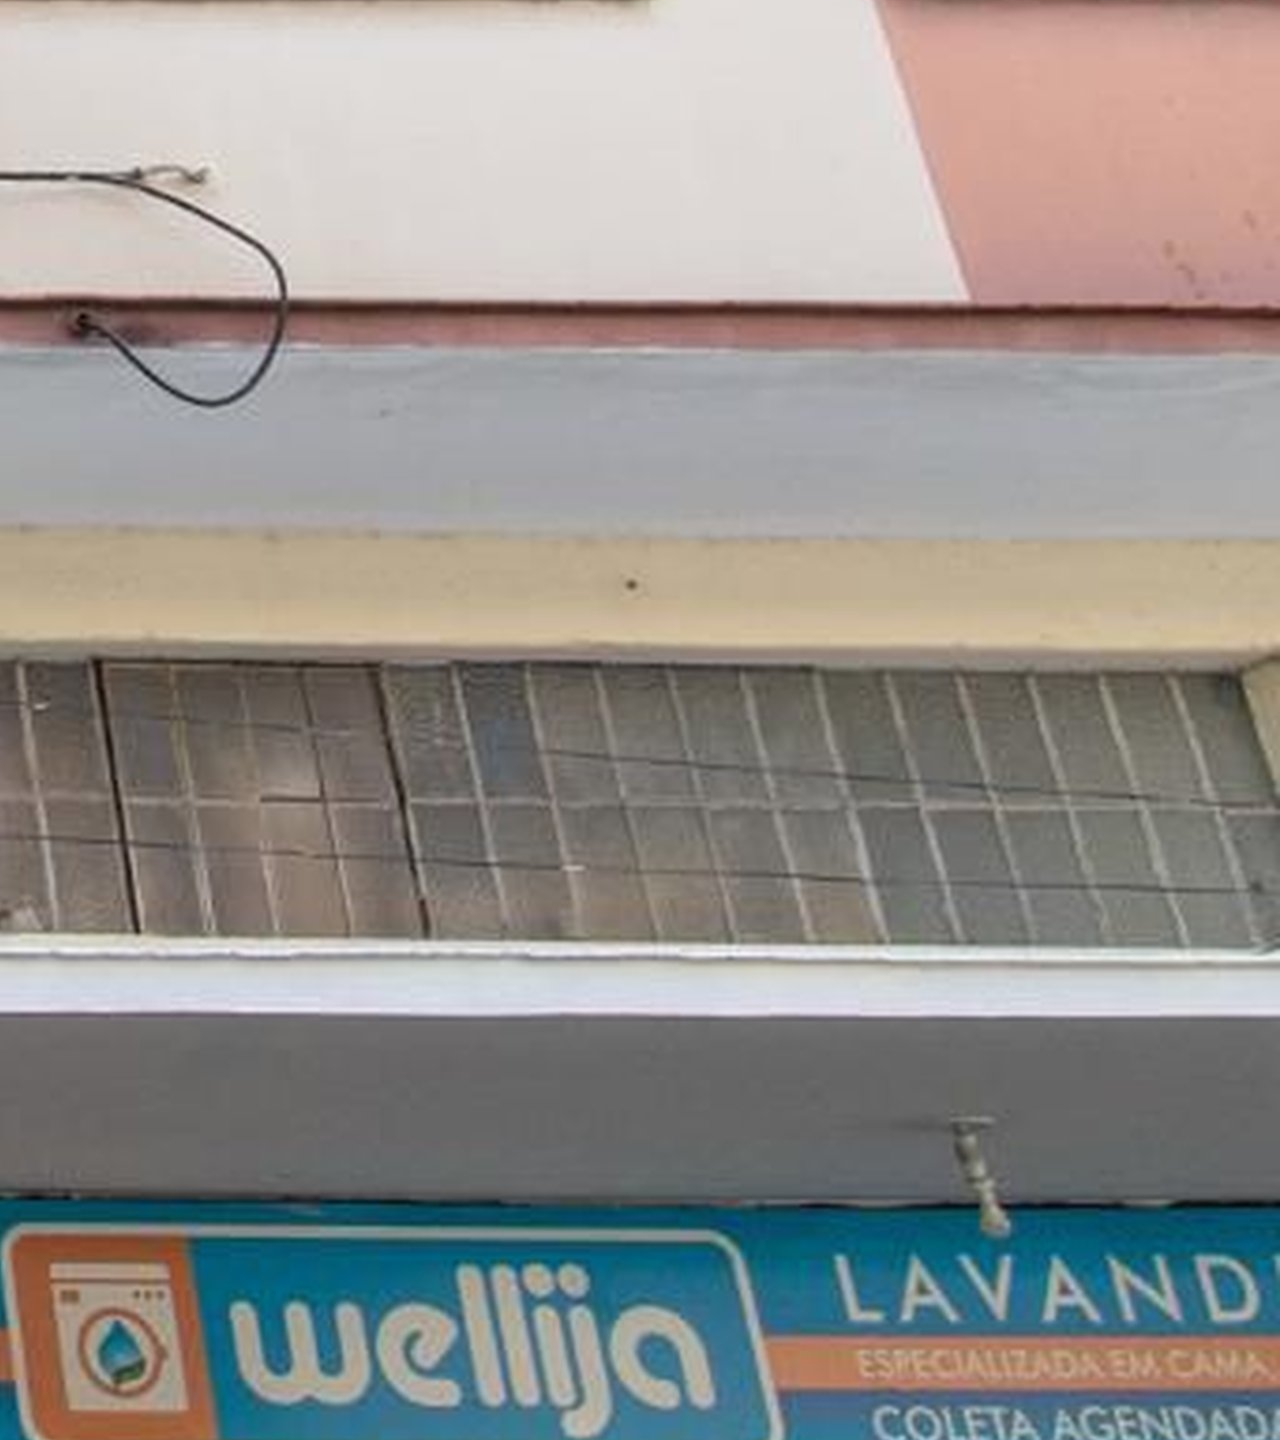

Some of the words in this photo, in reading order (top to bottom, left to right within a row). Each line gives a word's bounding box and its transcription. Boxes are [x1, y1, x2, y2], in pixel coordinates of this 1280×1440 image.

[834, 1253, 1280, 1323] LAVAND
[230, 1263, 715, 1439] wellija
[858, 1349, 1102, 1379] ESPECIALIZADA
[1114, 1349, 1162, 1379] EM
